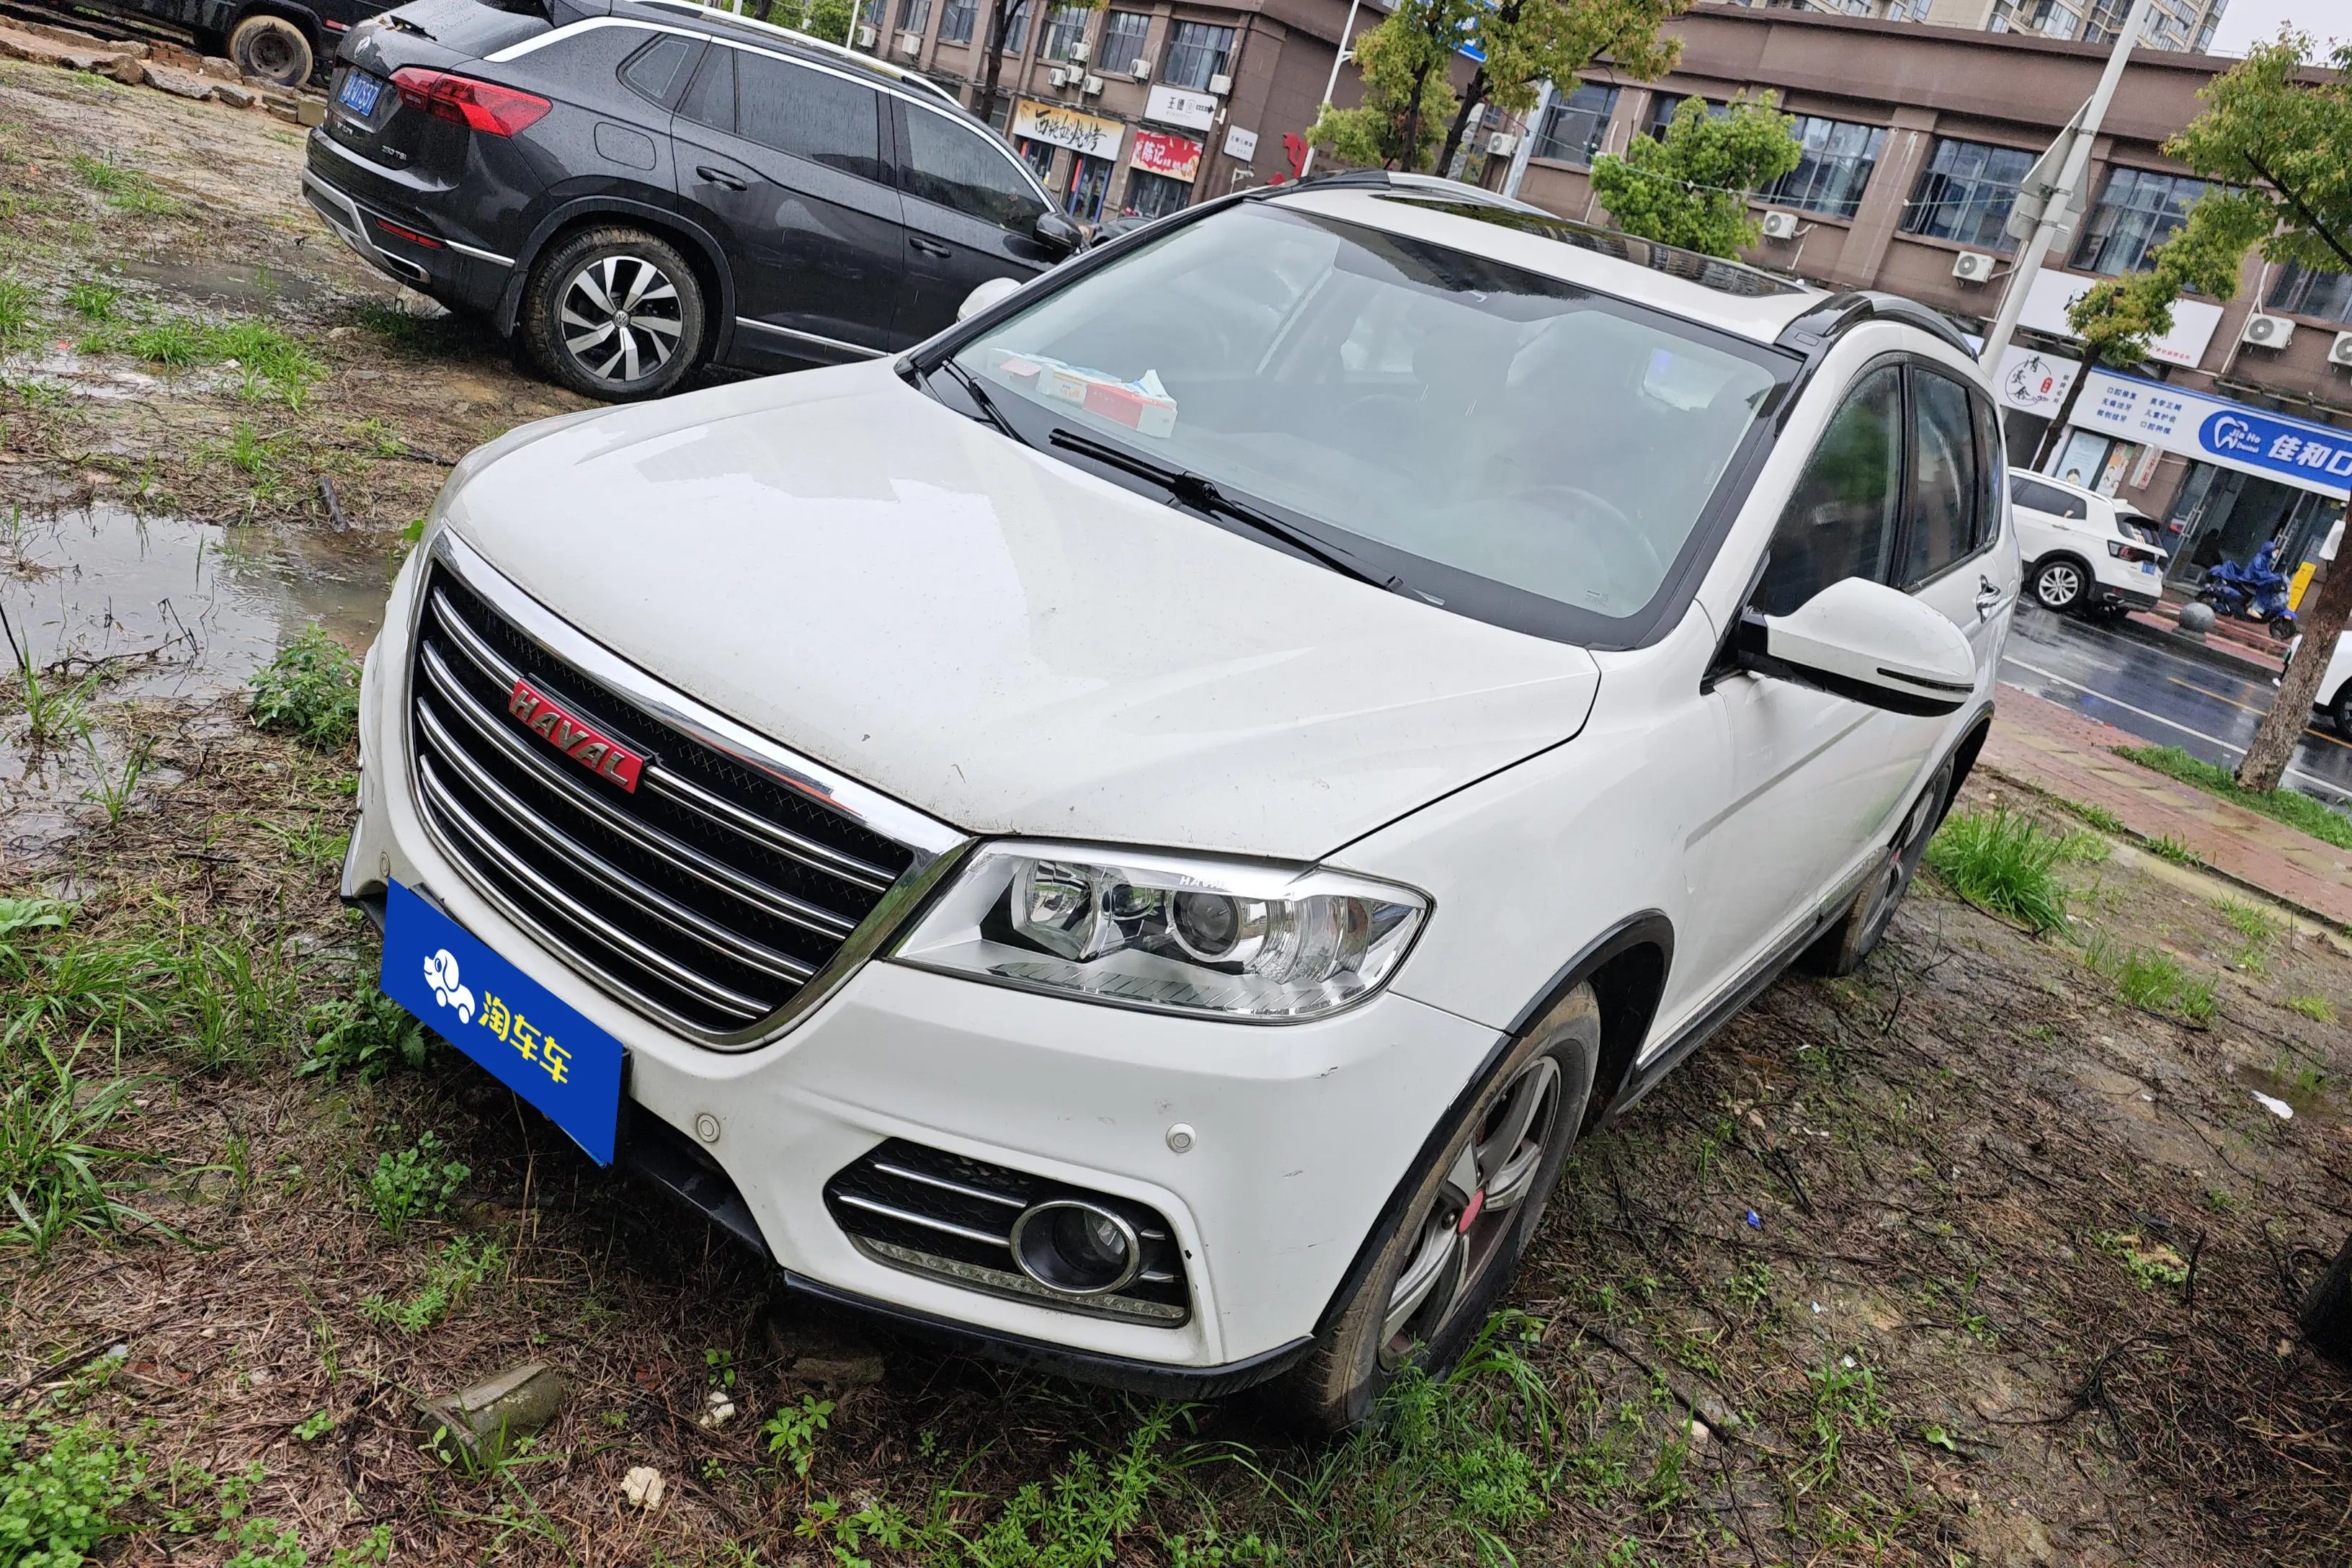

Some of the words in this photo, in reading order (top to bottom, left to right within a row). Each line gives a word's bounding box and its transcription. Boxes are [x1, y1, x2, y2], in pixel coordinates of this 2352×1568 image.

[2268, 434, 2352, 477] 佳和口
[509, 686, 629, 788] HAVAL
[1180, 875, 1225, 889] HAVA
